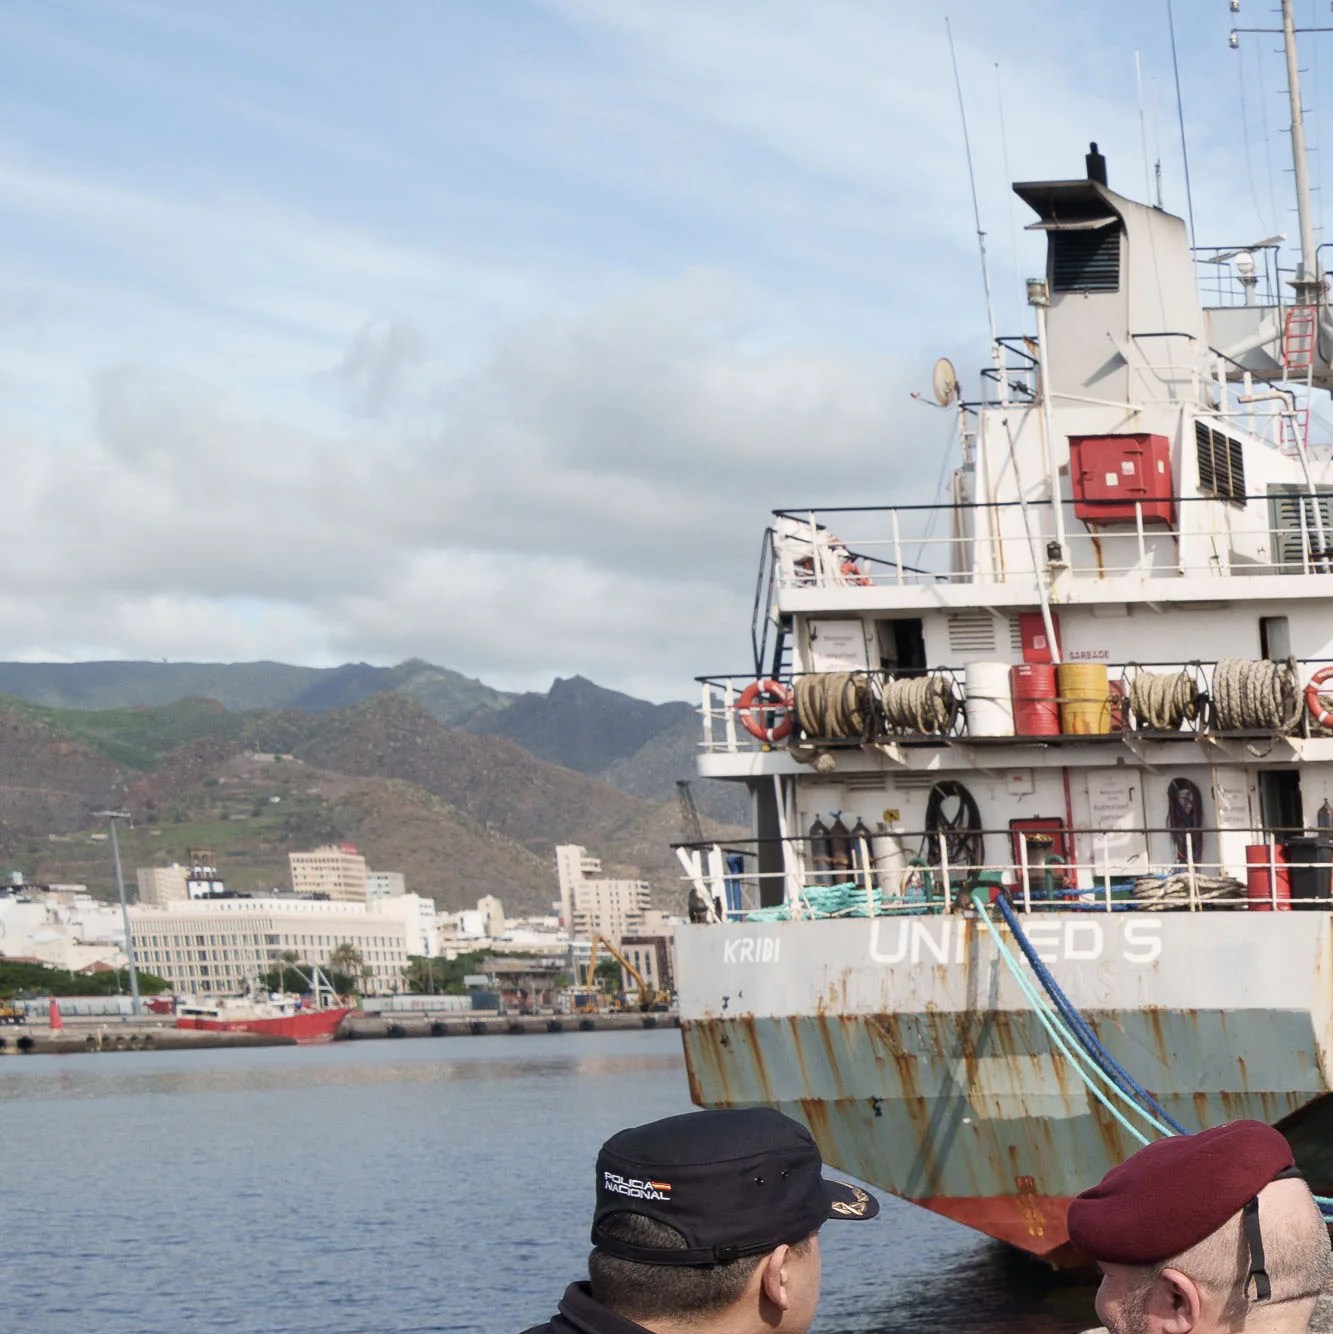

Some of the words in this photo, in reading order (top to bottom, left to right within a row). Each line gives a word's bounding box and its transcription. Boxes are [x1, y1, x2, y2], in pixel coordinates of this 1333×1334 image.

[1069, 650, 1110, 661] GARBAGE
[723, 936, 781, 964] KRIBI
[604, 1180, 671, 1201] NACIONAL
